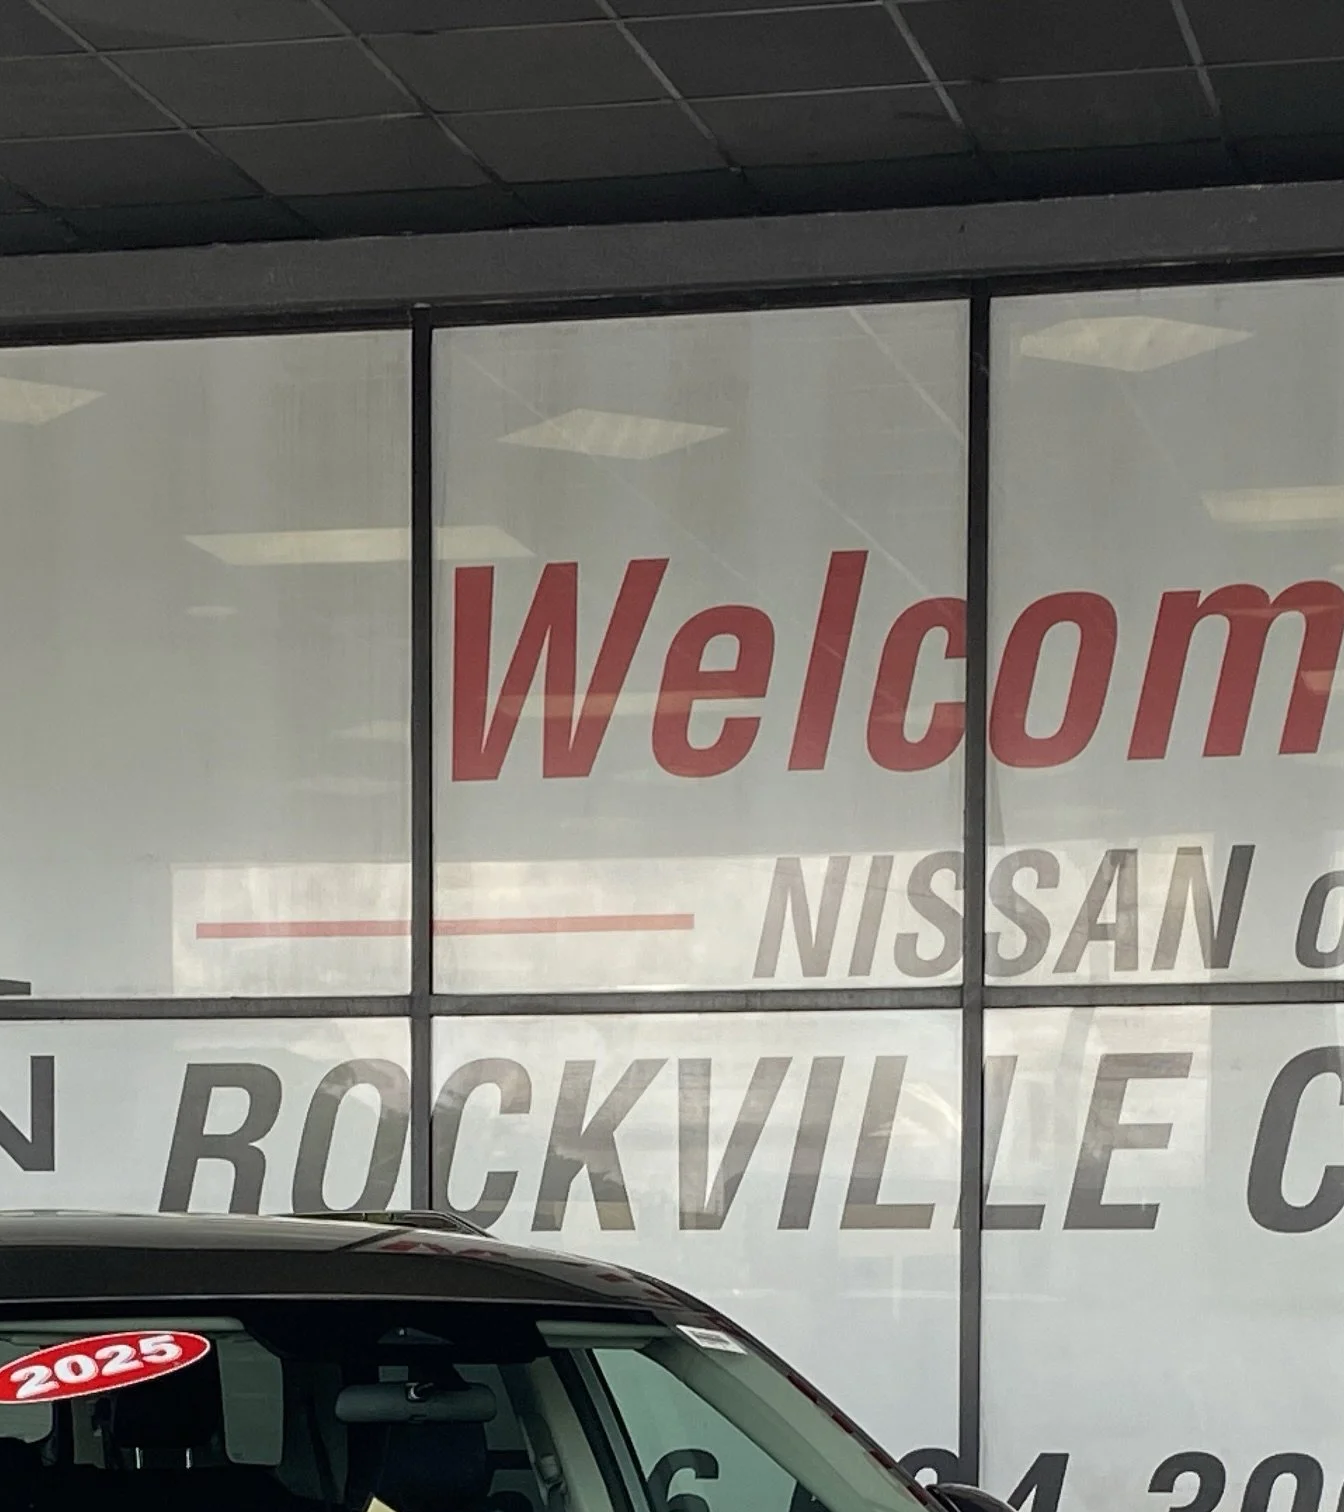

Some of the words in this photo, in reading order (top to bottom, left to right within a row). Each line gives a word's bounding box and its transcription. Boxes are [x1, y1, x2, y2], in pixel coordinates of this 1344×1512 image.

[752, 844, 1256, 979] NISSAN
[156, 1052, 1194, 1231] ROCKVILLE
[10, 1335, 183, 1399] 2025
